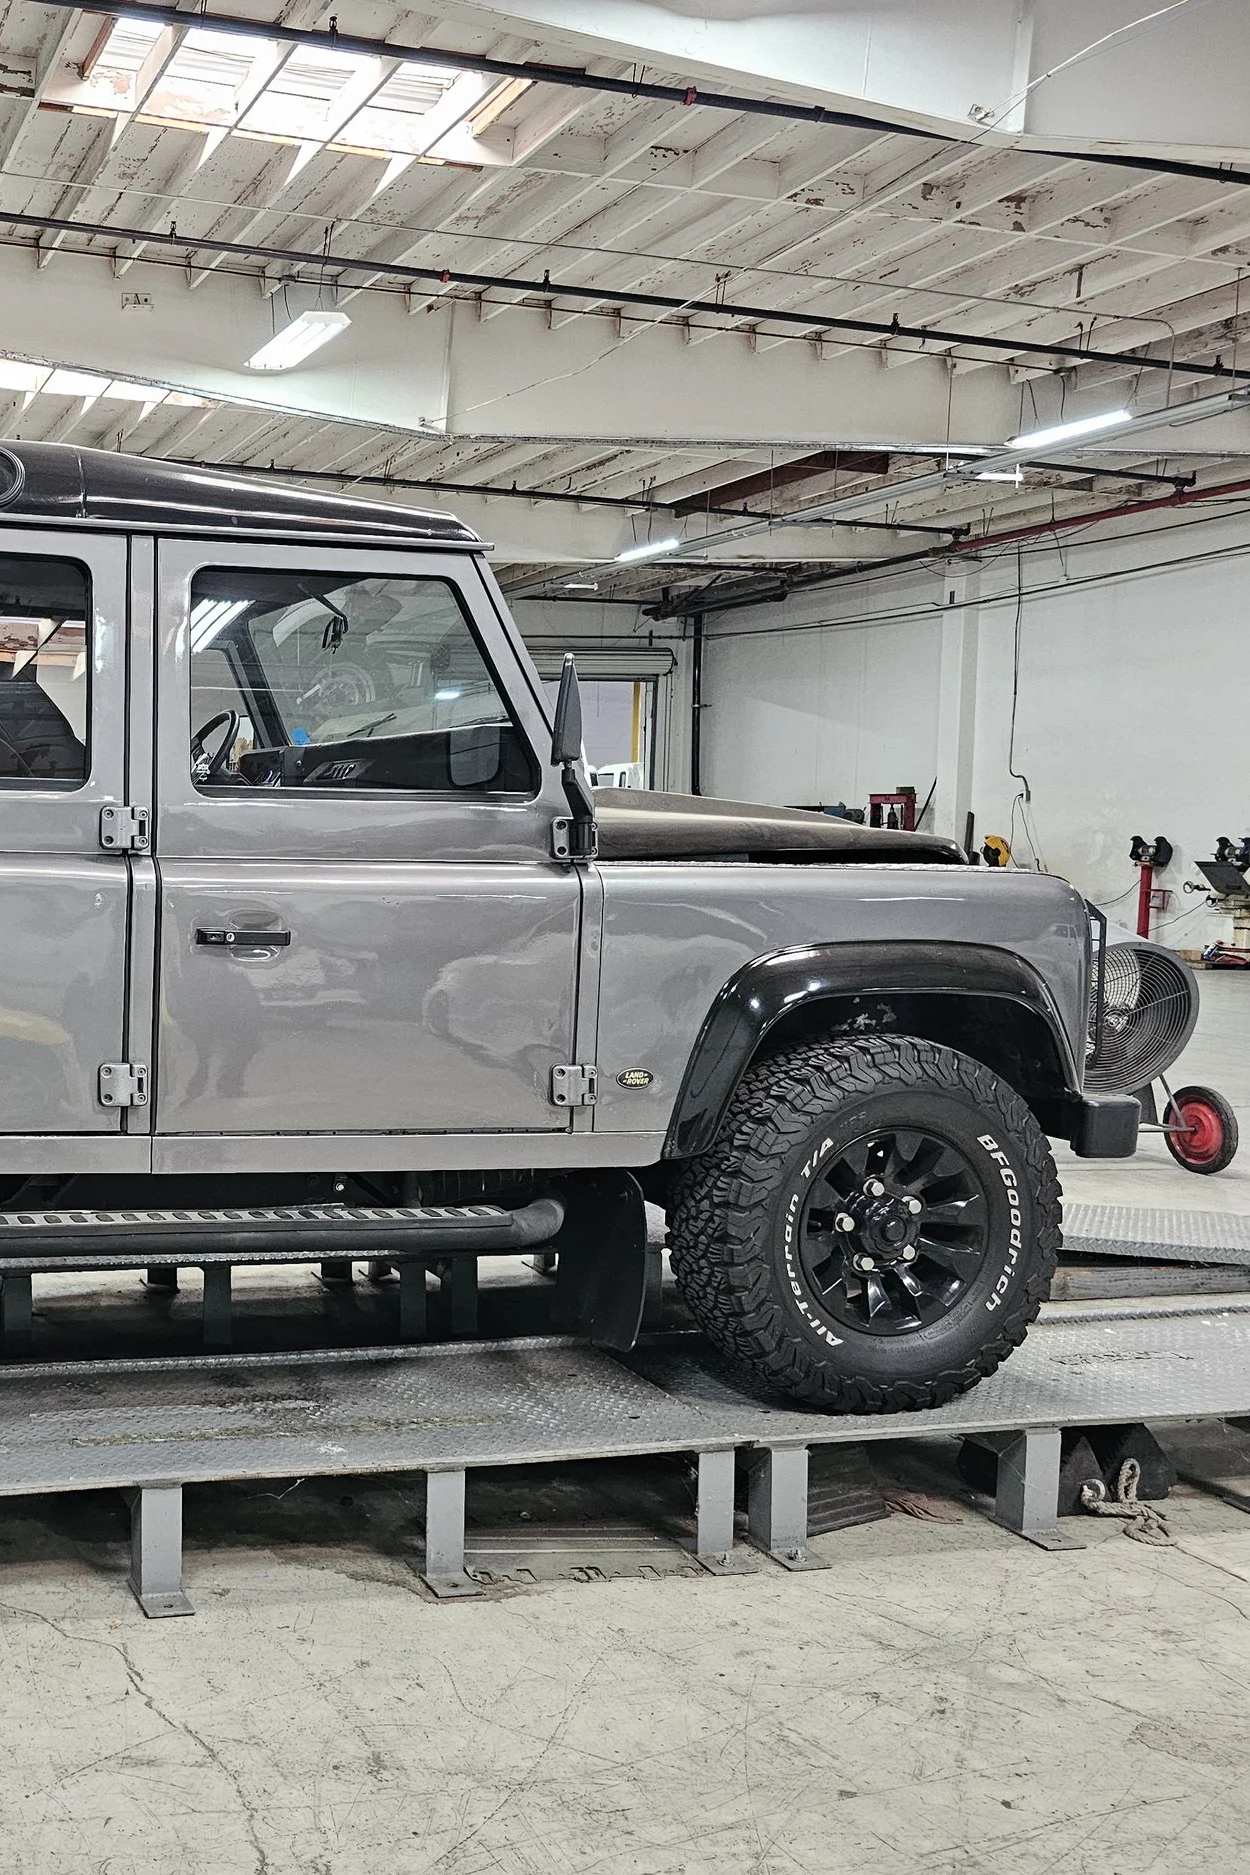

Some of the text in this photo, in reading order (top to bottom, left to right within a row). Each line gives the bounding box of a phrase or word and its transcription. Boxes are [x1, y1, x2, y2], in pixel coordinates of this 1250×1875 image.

[625, 1071, 644, 1079] LAND
[784, 1137, 844, 1347] All-Terrain T/A
[976, 1134, 1024, 1311] BFGoodrich
